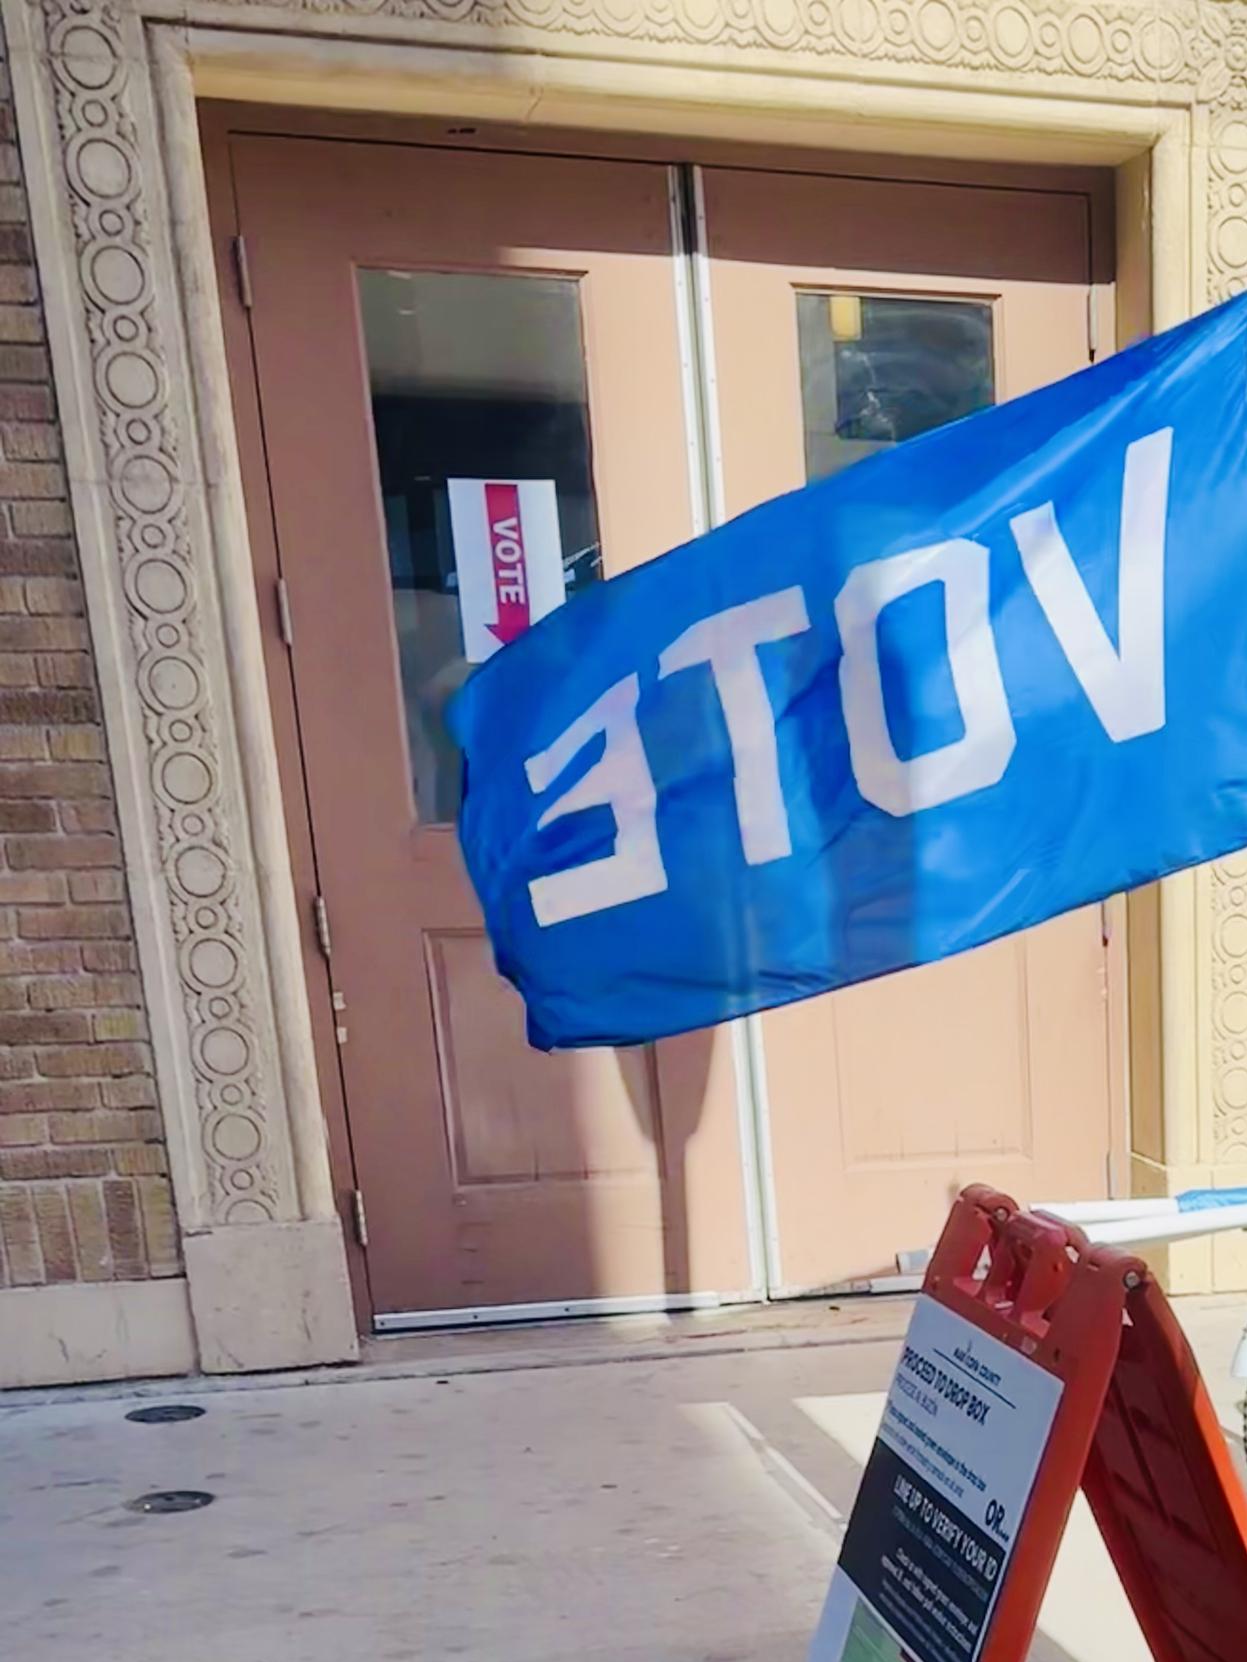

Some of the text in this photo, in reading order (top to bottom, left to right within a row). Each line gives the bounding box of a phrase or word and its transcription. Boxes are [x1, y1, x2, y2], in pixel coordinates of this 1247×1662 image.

[493, 517, 525, 605] VOTE
[934, 1370, 948, 1394] TO
[944, 1378, 970, 1410] DROP
[966, 1394, 991, 1427] BOX
[908, 1487, 923, 1512] UP
[920, 1497, 935, 1523] TO
[931, 1508, 964, 1550] VERIFY
[960, 1533, 988, 1573] YOUR
[984, 1556, 999, 1582] ID
